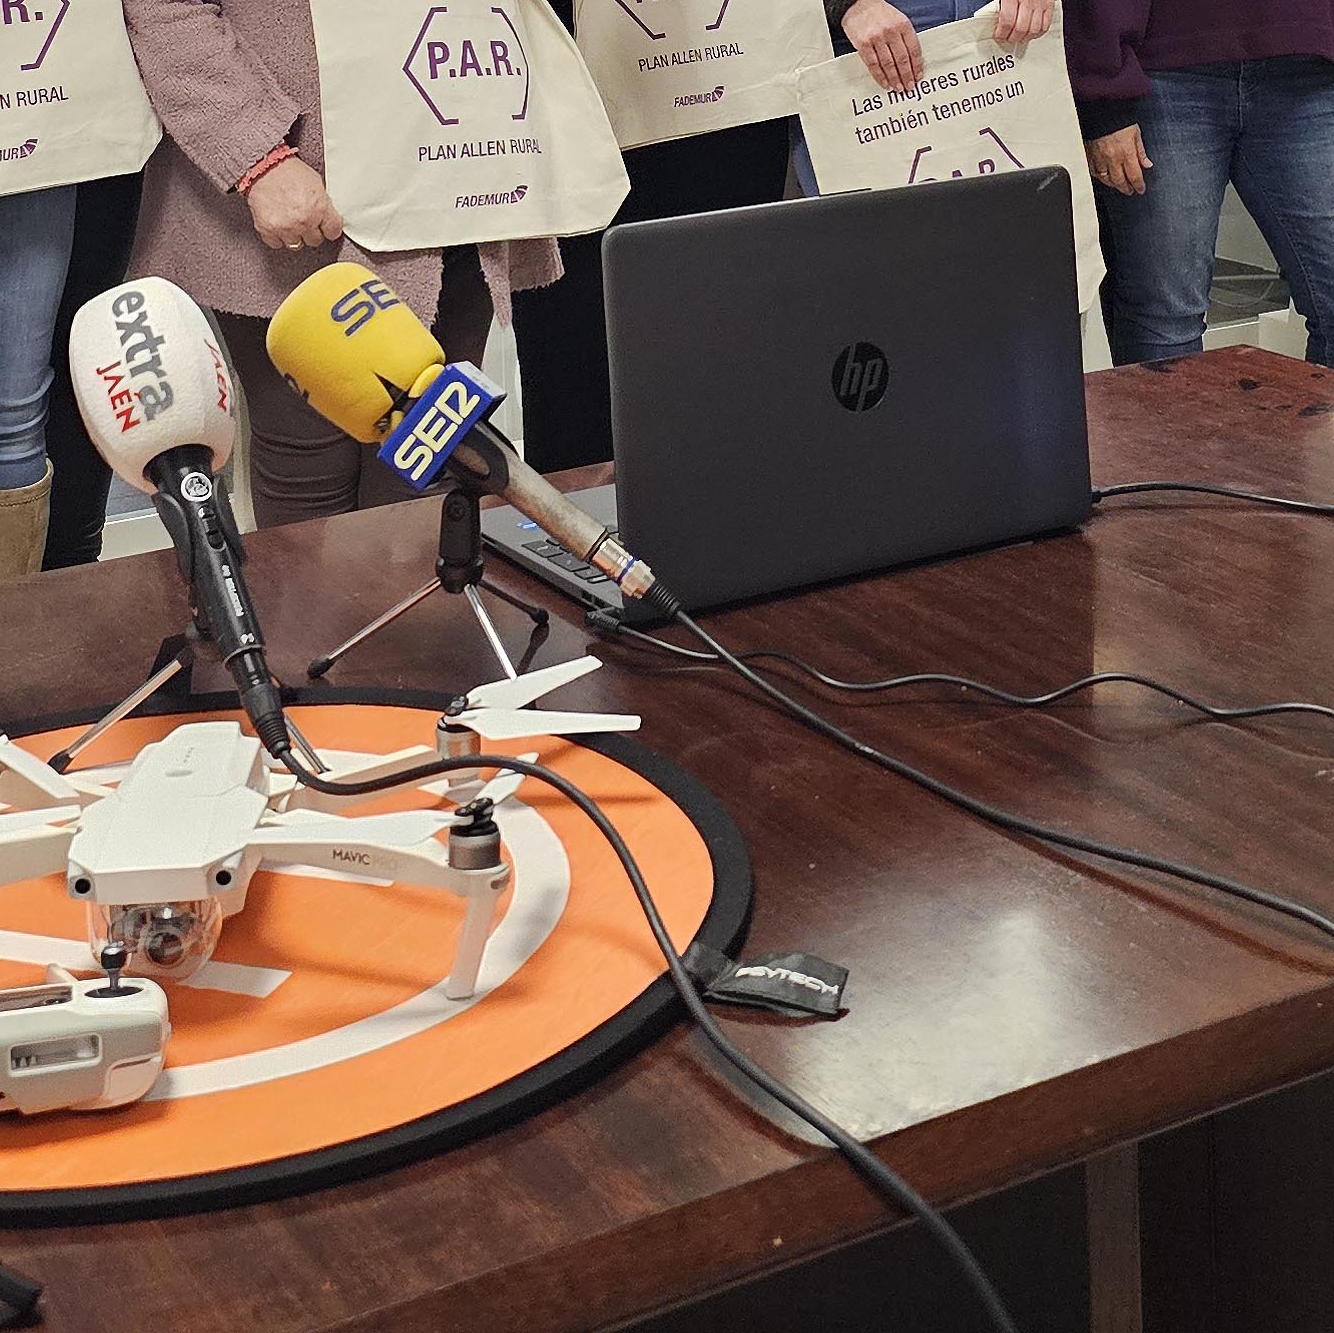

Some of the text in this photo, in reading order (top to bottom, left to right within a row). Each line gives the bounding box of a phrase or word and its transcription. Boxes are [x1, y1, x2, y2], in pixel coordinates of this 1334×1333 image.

[427, 39, 522, 80] P.A.R.
[638, 42, 744, 72] PLAN ALLEN RURAL
[16, 85, 70, 108] RURAL
[674, 92, 714, 108] FADEMUR
[851, 95, 883, 117] Las
[962, 53, 1016, 84] rurales
[855, 79, 1025, 144] también tenemos un
[418, 138, 542, 162] PLAN ALLEN RURAL
[455, 192, 511, 208] FADEMUR
[331, 280, 400, 336] SE
[112, 291, 174, 421] extra
[840, 342, 881, 412] hp
[394, 381, 480, 481] SER
[332, 849, 370, 865] MAVIC
